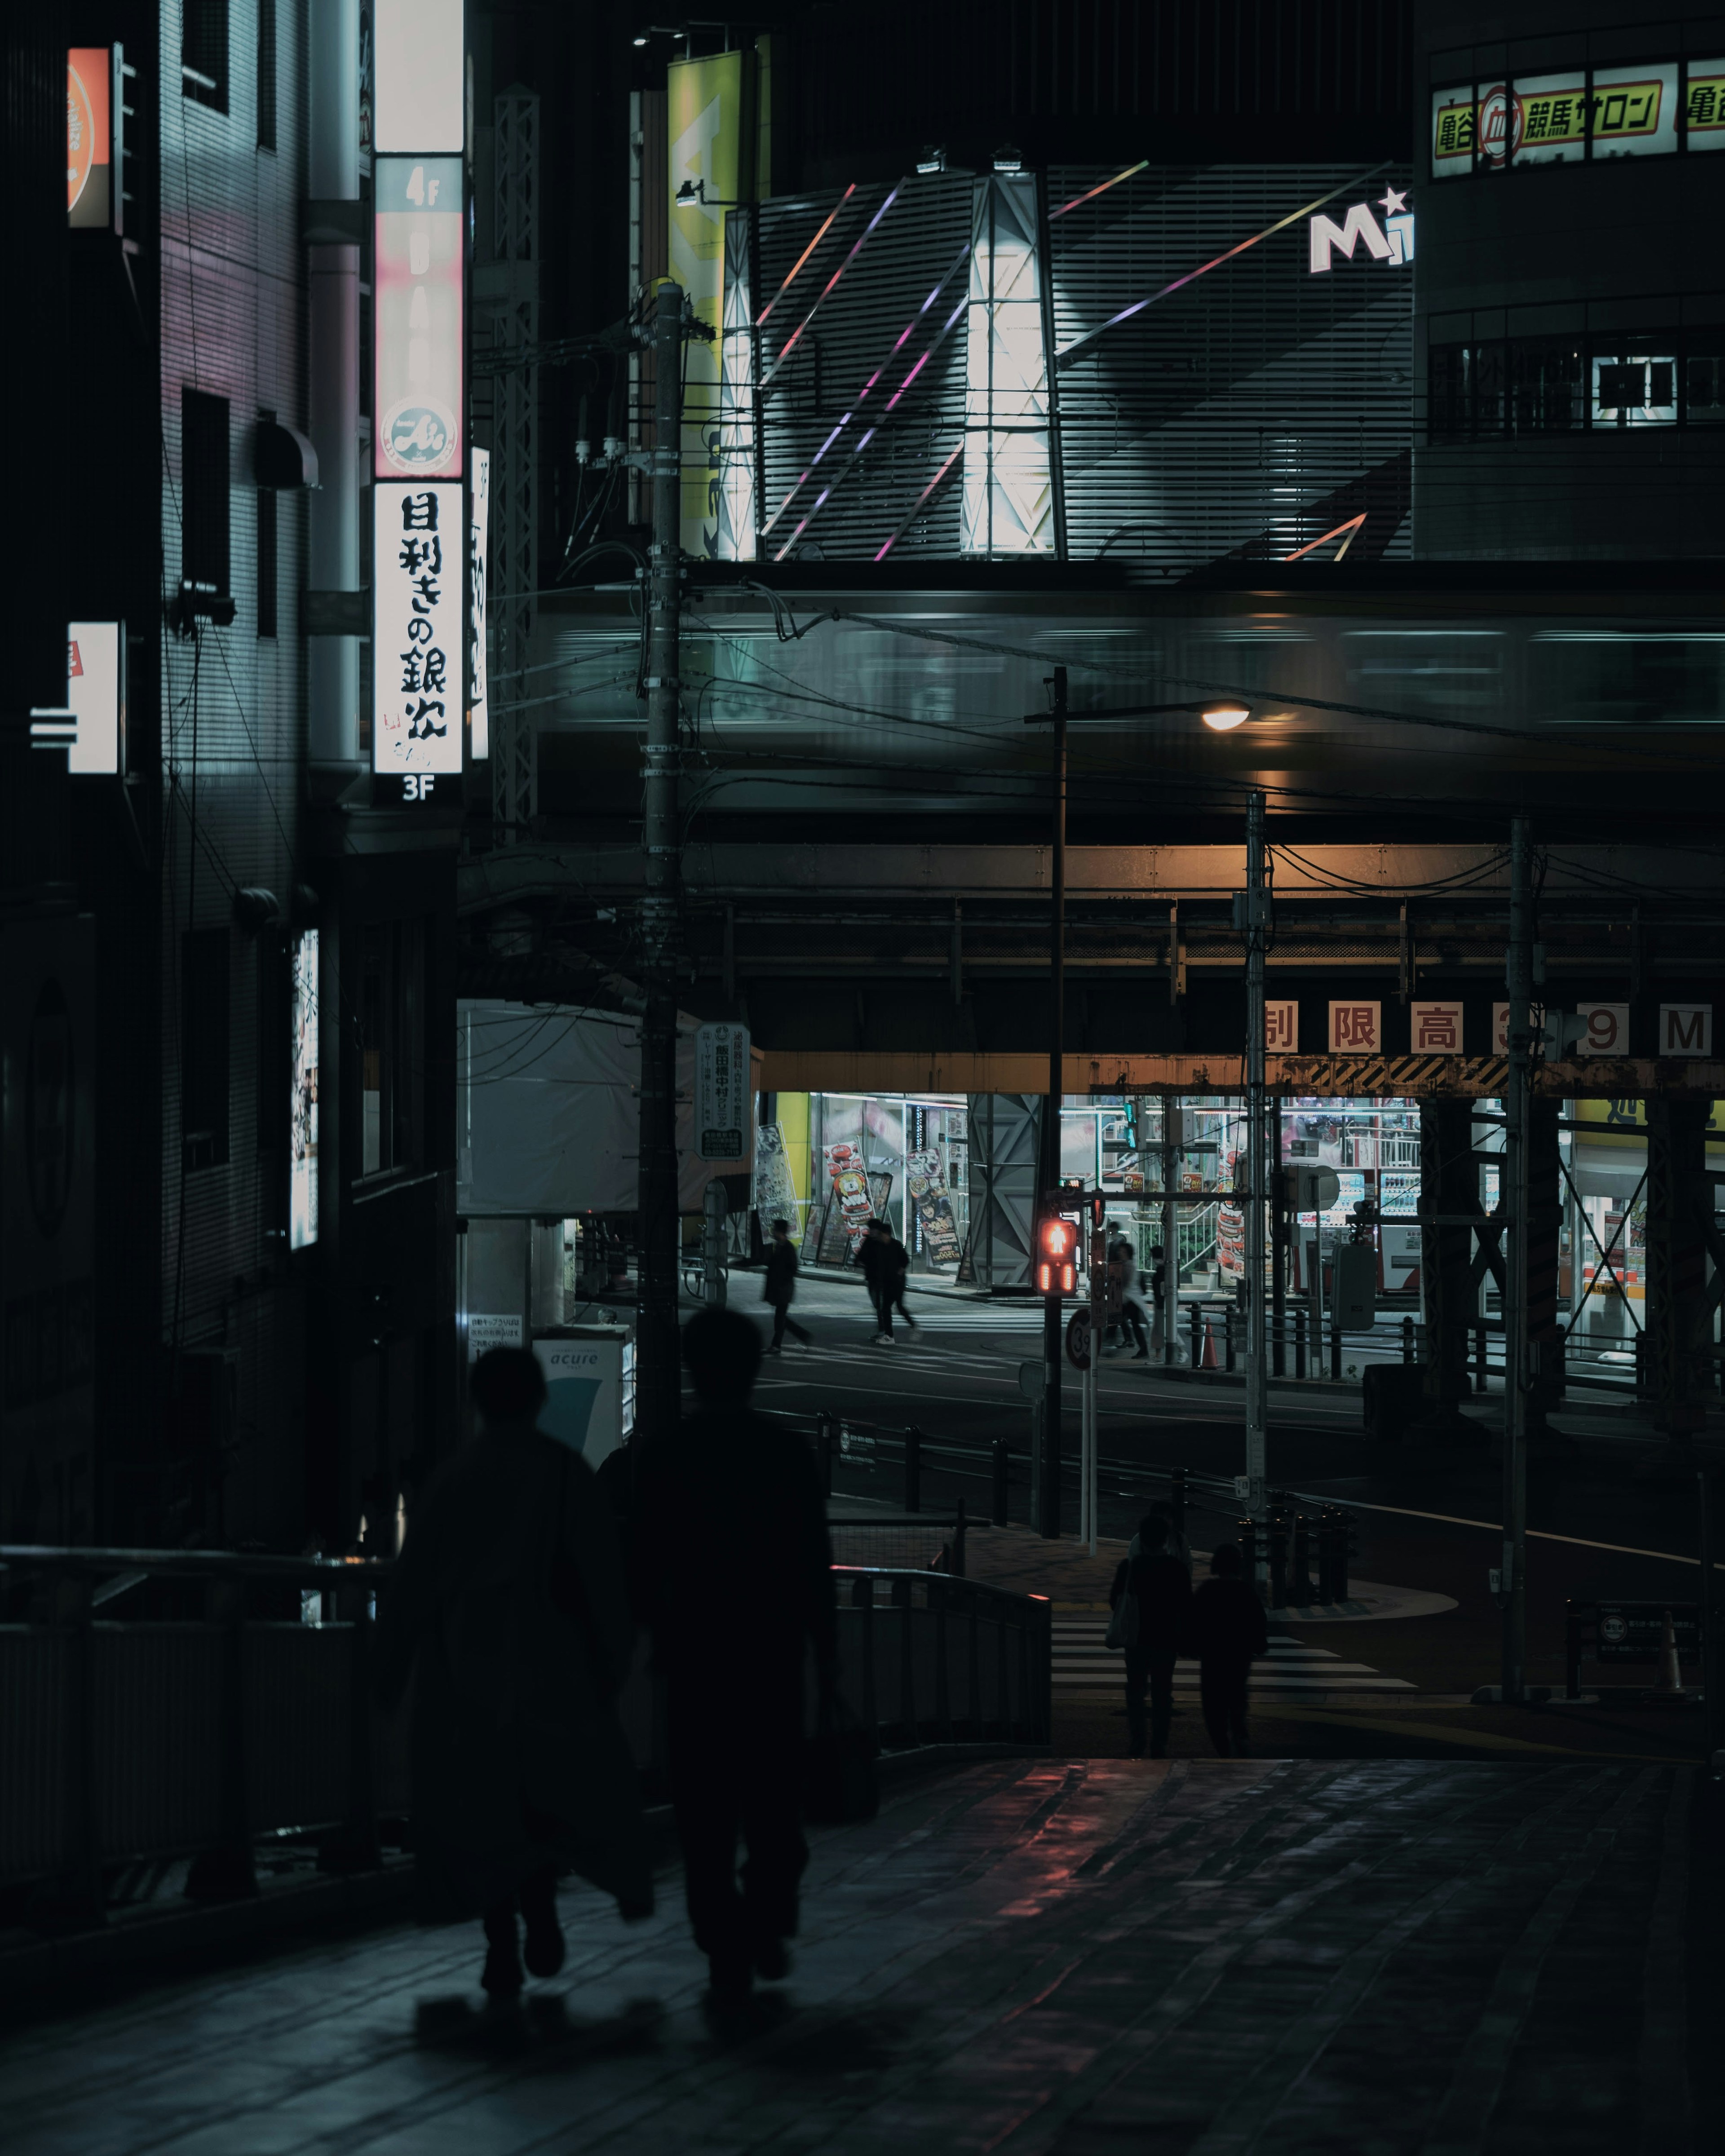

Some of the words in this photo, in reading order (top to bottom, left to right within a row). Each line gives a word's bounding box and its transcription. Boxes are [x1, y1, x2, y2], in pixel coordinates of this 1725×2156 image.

[1526, 91, 1655, 139] 競馬サロン
[406, 166, 440, 206] 4F
[399, 491, 447, 740] 目利きの銀次
[402, 774, 435, 801] 3F
[715, 1044, 729, 1128] 飯田橋中村クリニック
[550, 1354, 598, 1365] acure
